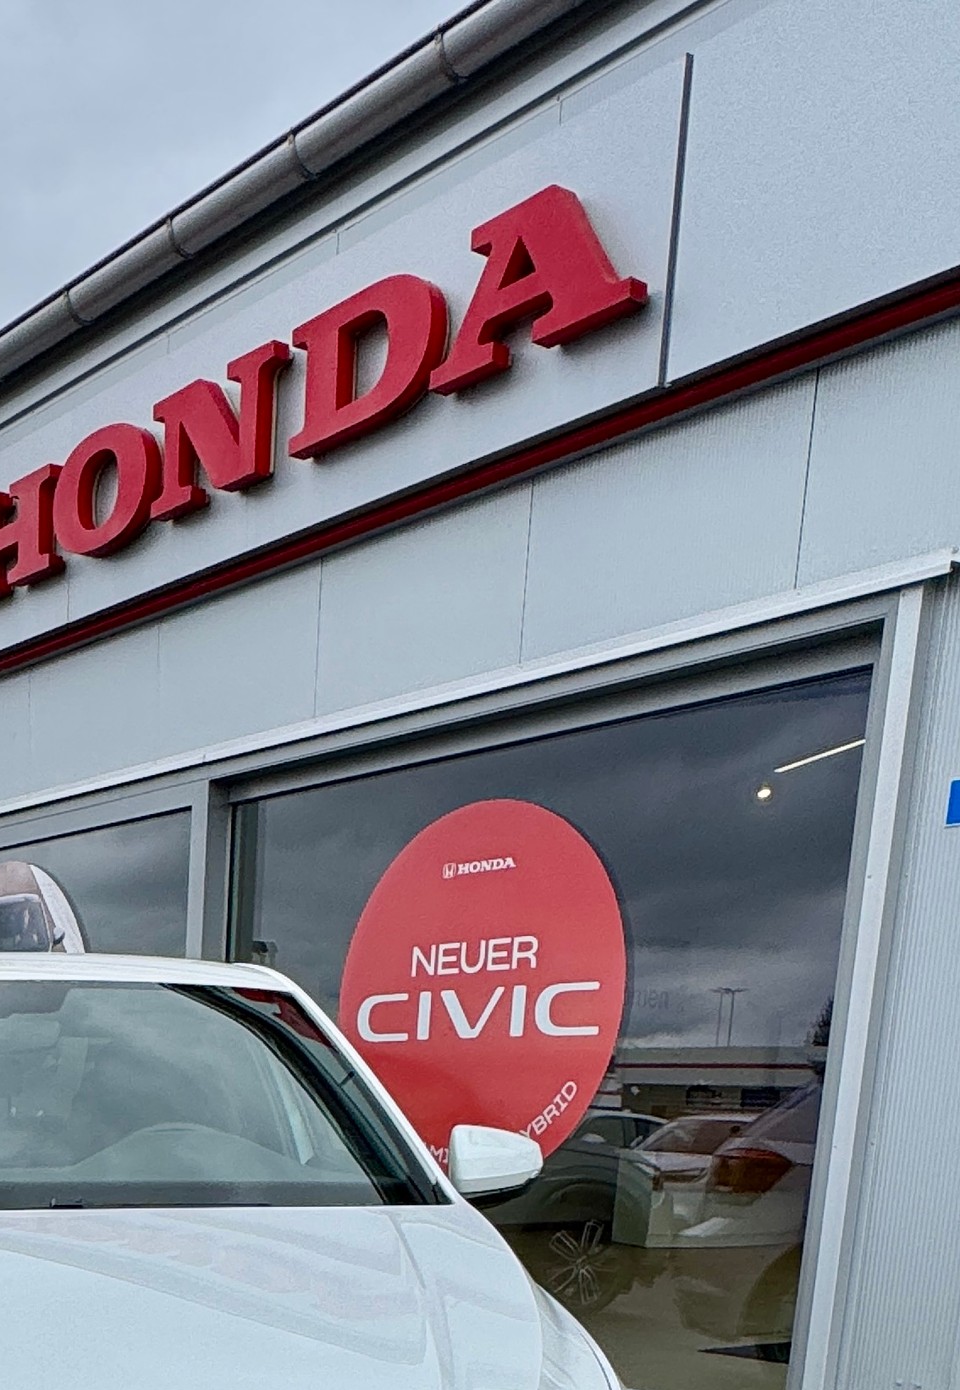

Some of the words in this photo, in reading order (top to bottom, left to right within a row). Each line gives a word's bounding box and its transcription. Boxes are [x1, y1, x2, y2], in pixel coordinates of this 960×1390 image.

[457, 857, 516, 876] HONDA
[410, 935, 539, 978] NEUER
[356, 981, 601, 1042] CIVIC
[519, 1081, 578, 1139] YBRID
